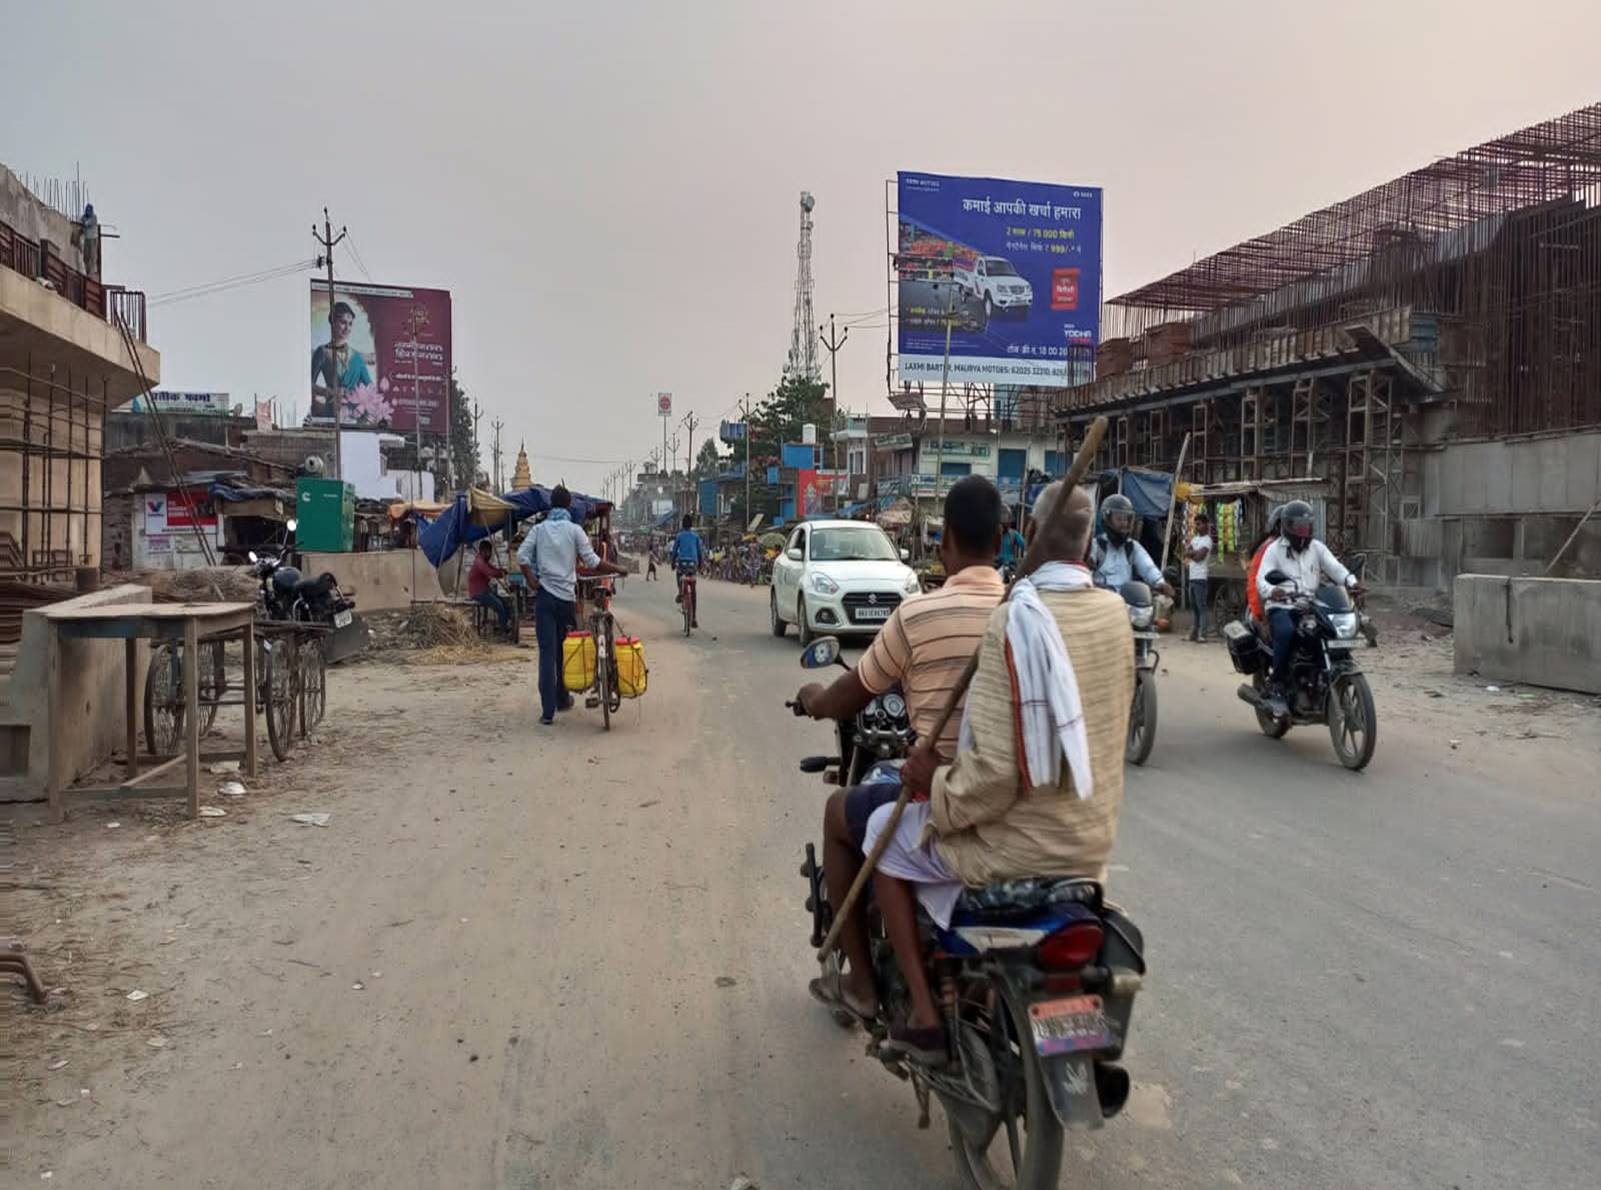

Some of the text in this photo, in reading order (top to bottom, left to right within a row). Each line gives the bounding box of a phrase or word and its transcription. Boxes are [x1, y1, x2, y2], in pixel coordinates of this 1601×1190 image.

[962, 196, 1081, 220] कमाई आपकी खर्चा हमारा
